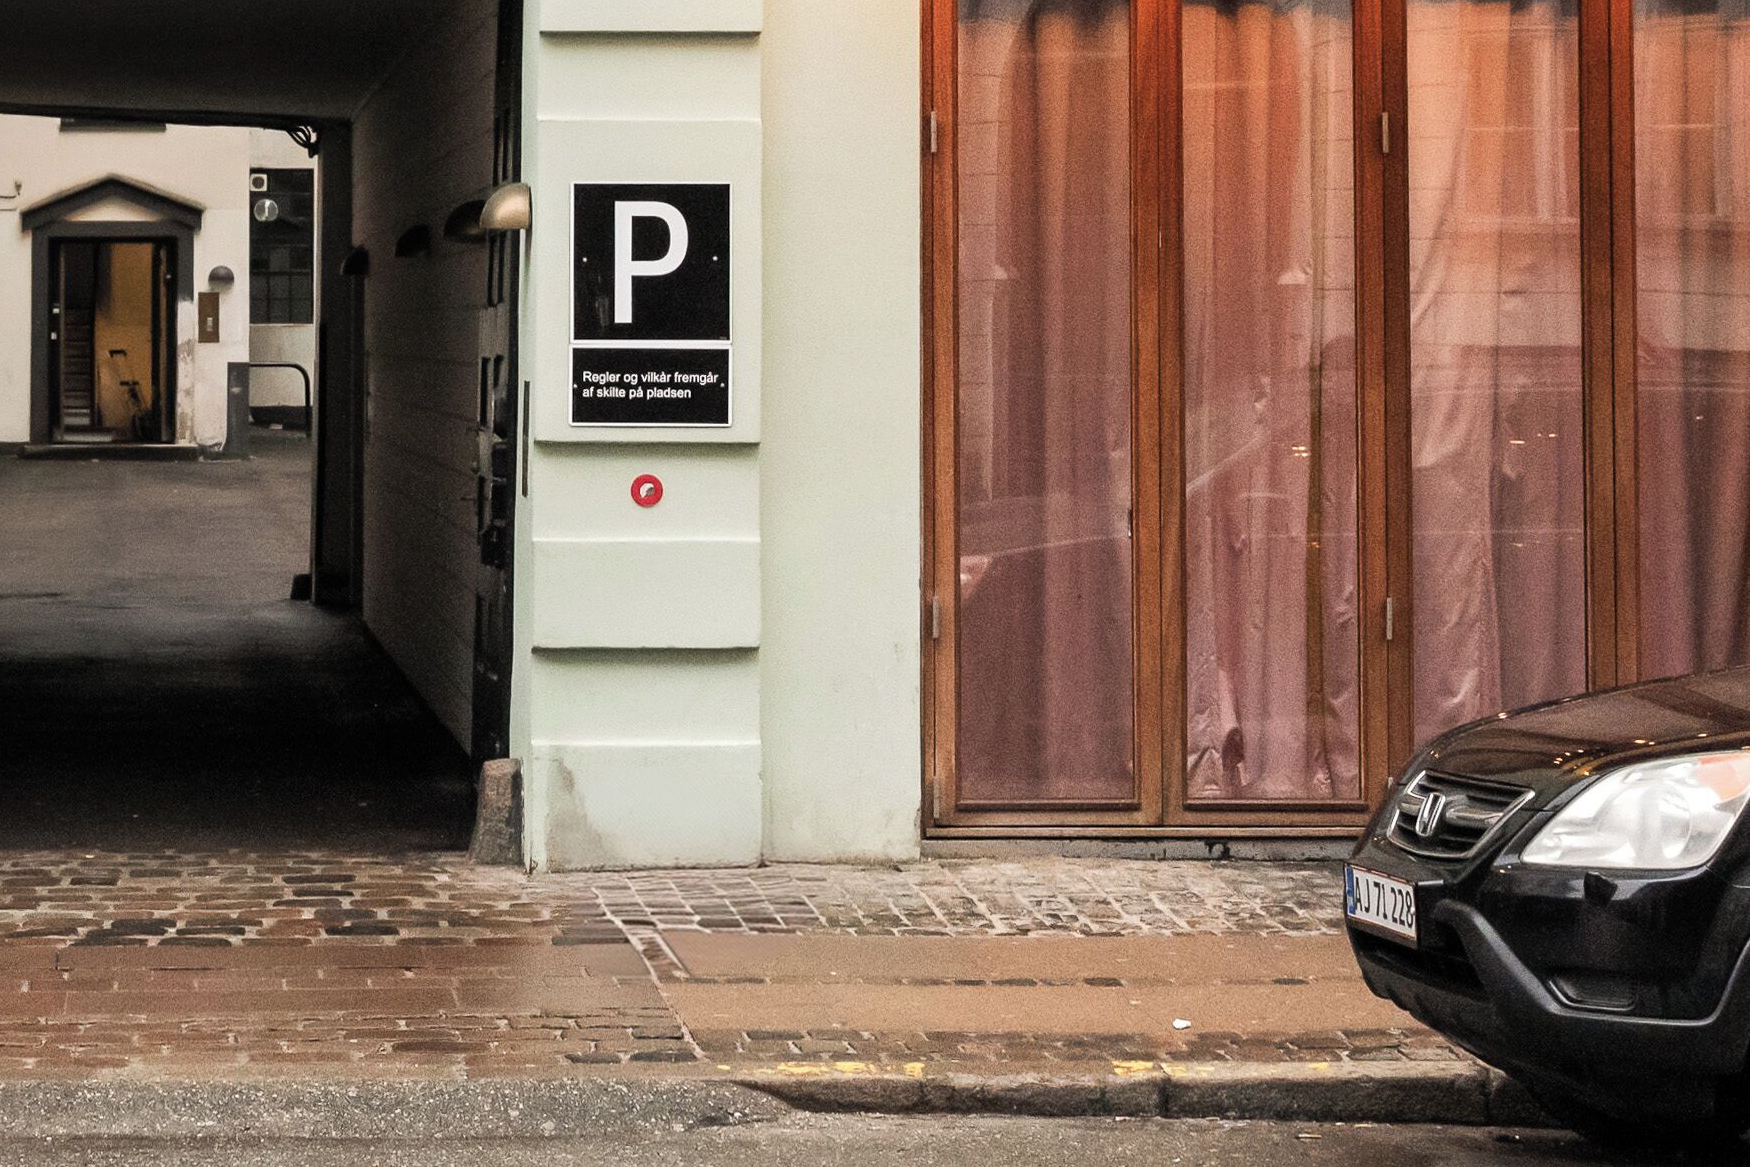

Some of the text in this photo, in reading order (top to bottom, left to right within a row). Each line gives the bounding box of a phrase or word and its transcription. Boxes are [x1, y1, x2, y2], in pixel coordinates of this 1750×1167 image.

[614, 201, 688, 323] P
[582, 371, 719, 385] Regler og vilkår fremgår
[582, 386, 692, 400] af skilte på pladsen
[1355, 876, 1413, 928] AJ 71 228
